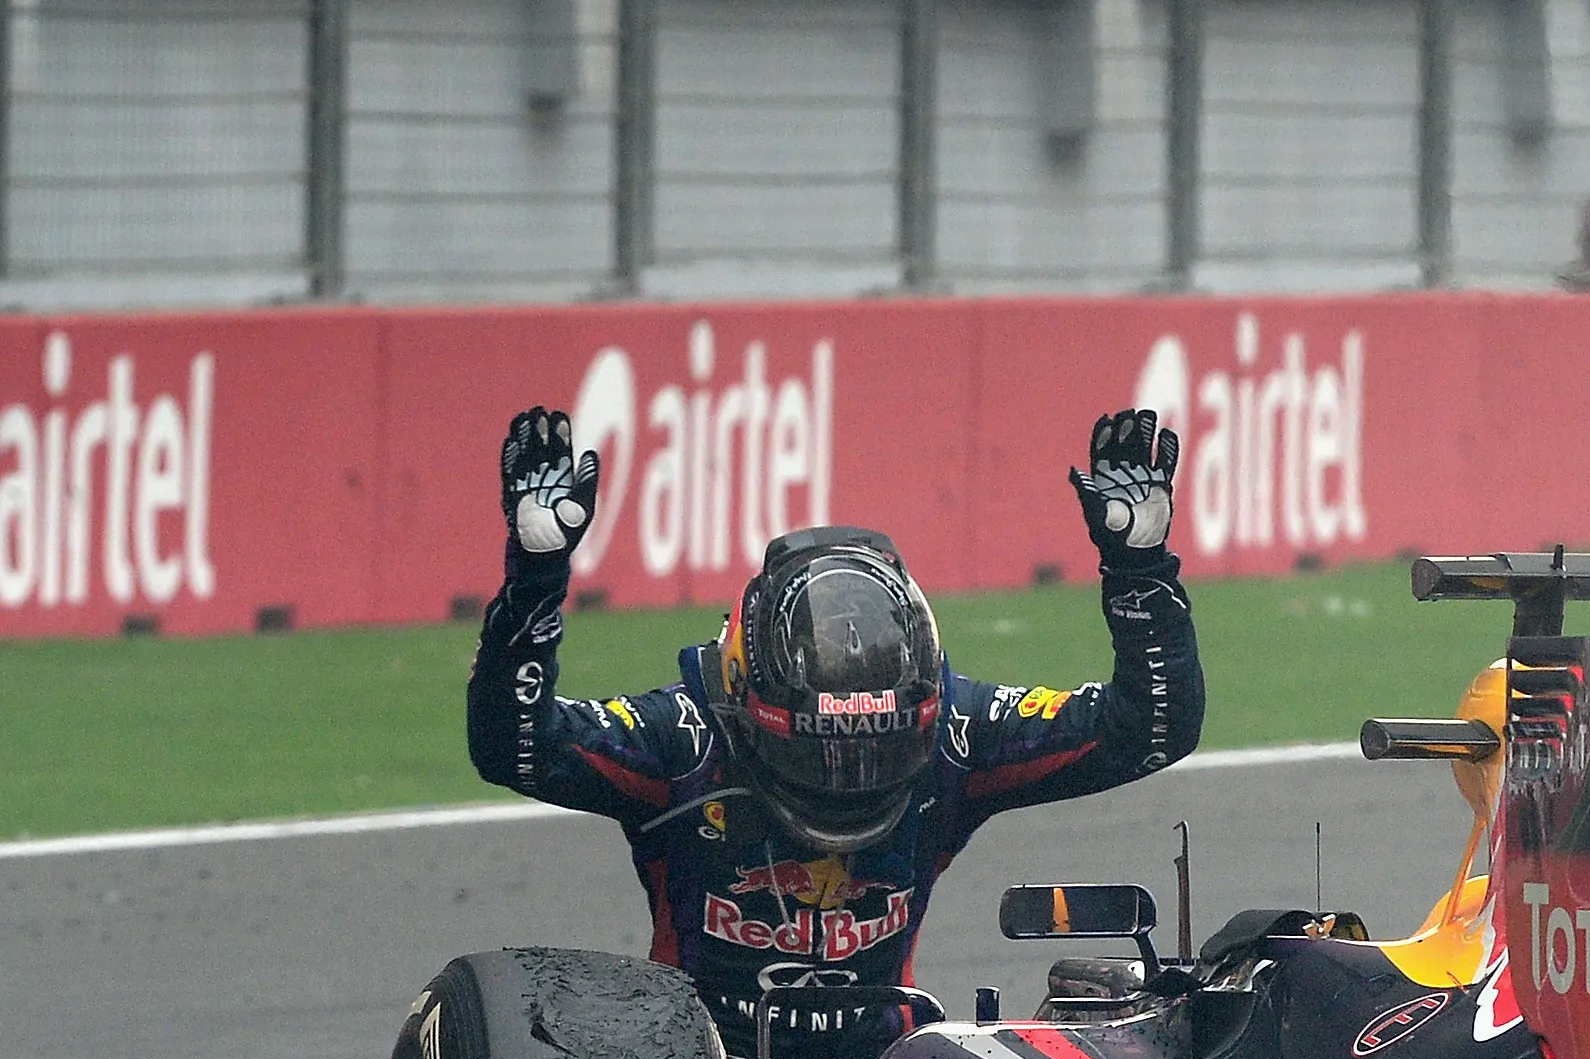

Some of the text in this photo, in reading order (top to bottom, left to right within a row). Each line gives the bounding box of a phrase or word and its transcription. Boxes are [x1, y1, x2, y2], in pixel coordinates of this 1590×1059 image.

[0, 331, 215, 605] airtel
[639, 318, 835, 577] airtel
[1194, 311, 1367, 555] airtel
[795, 706, 917, 735] RENAULT
[704, 887, 915, 961] Red Bull
